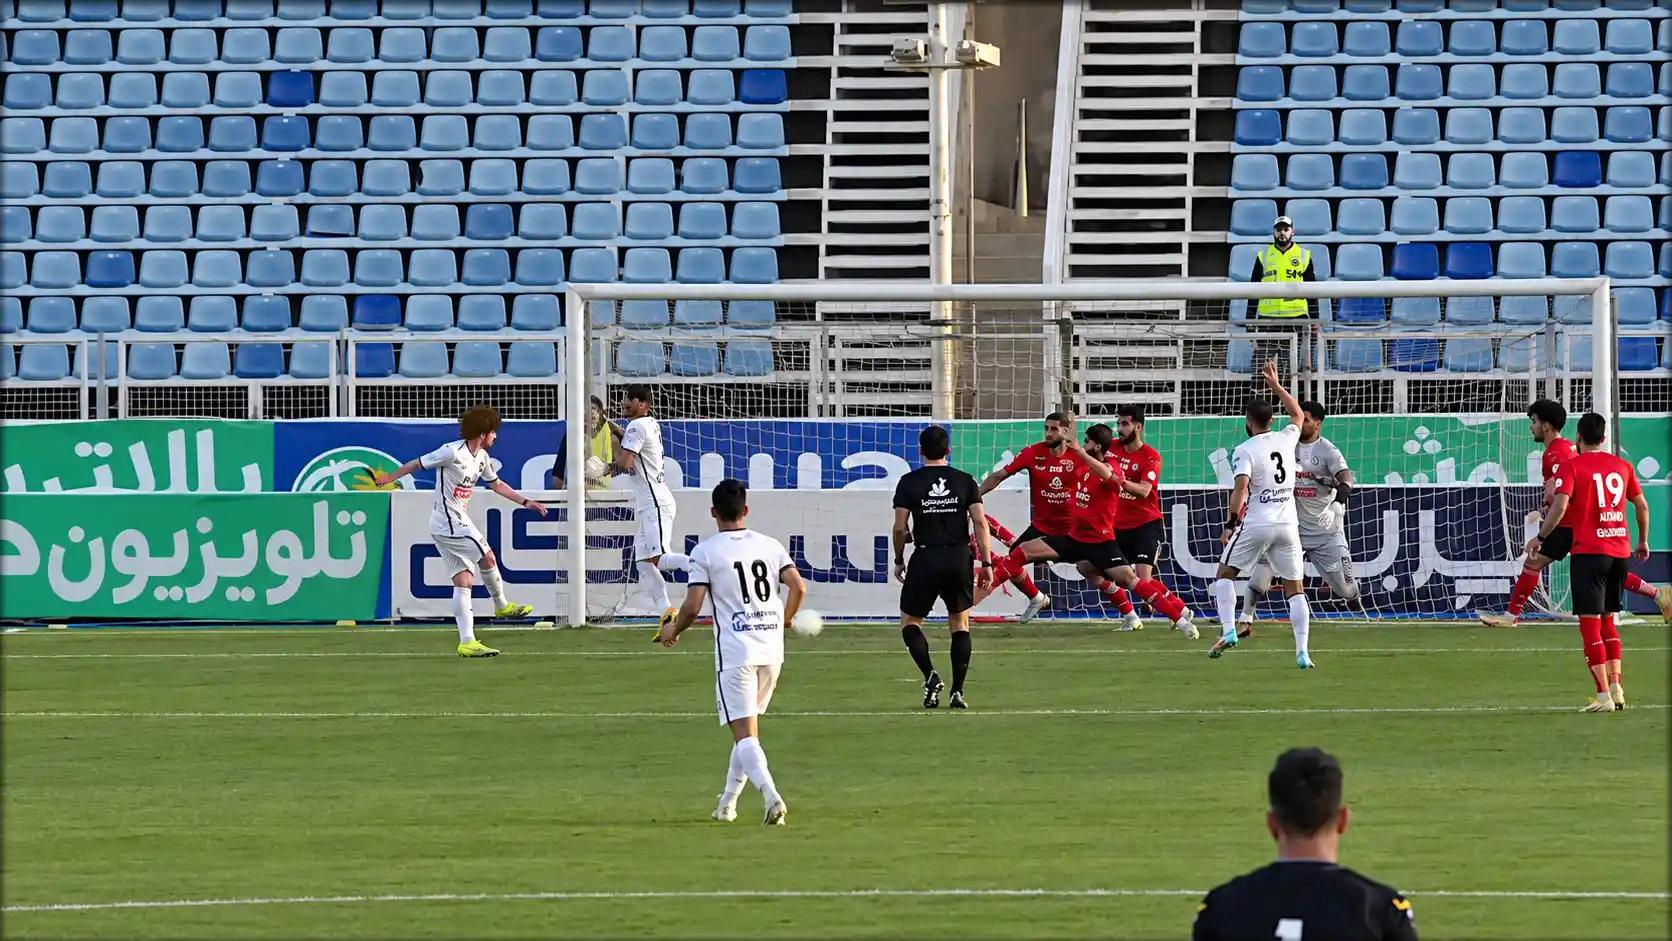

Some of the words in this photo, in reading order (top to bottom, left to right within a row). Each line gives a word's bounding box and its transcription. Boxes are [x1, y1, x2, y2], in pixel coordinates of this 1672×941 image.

[1270, 451, 1287, 485] 3
[1592, 472, 1625, 508] 19
[47, 499, 368, 606] تلویزیون
[733, 559, 771, 604] 18
